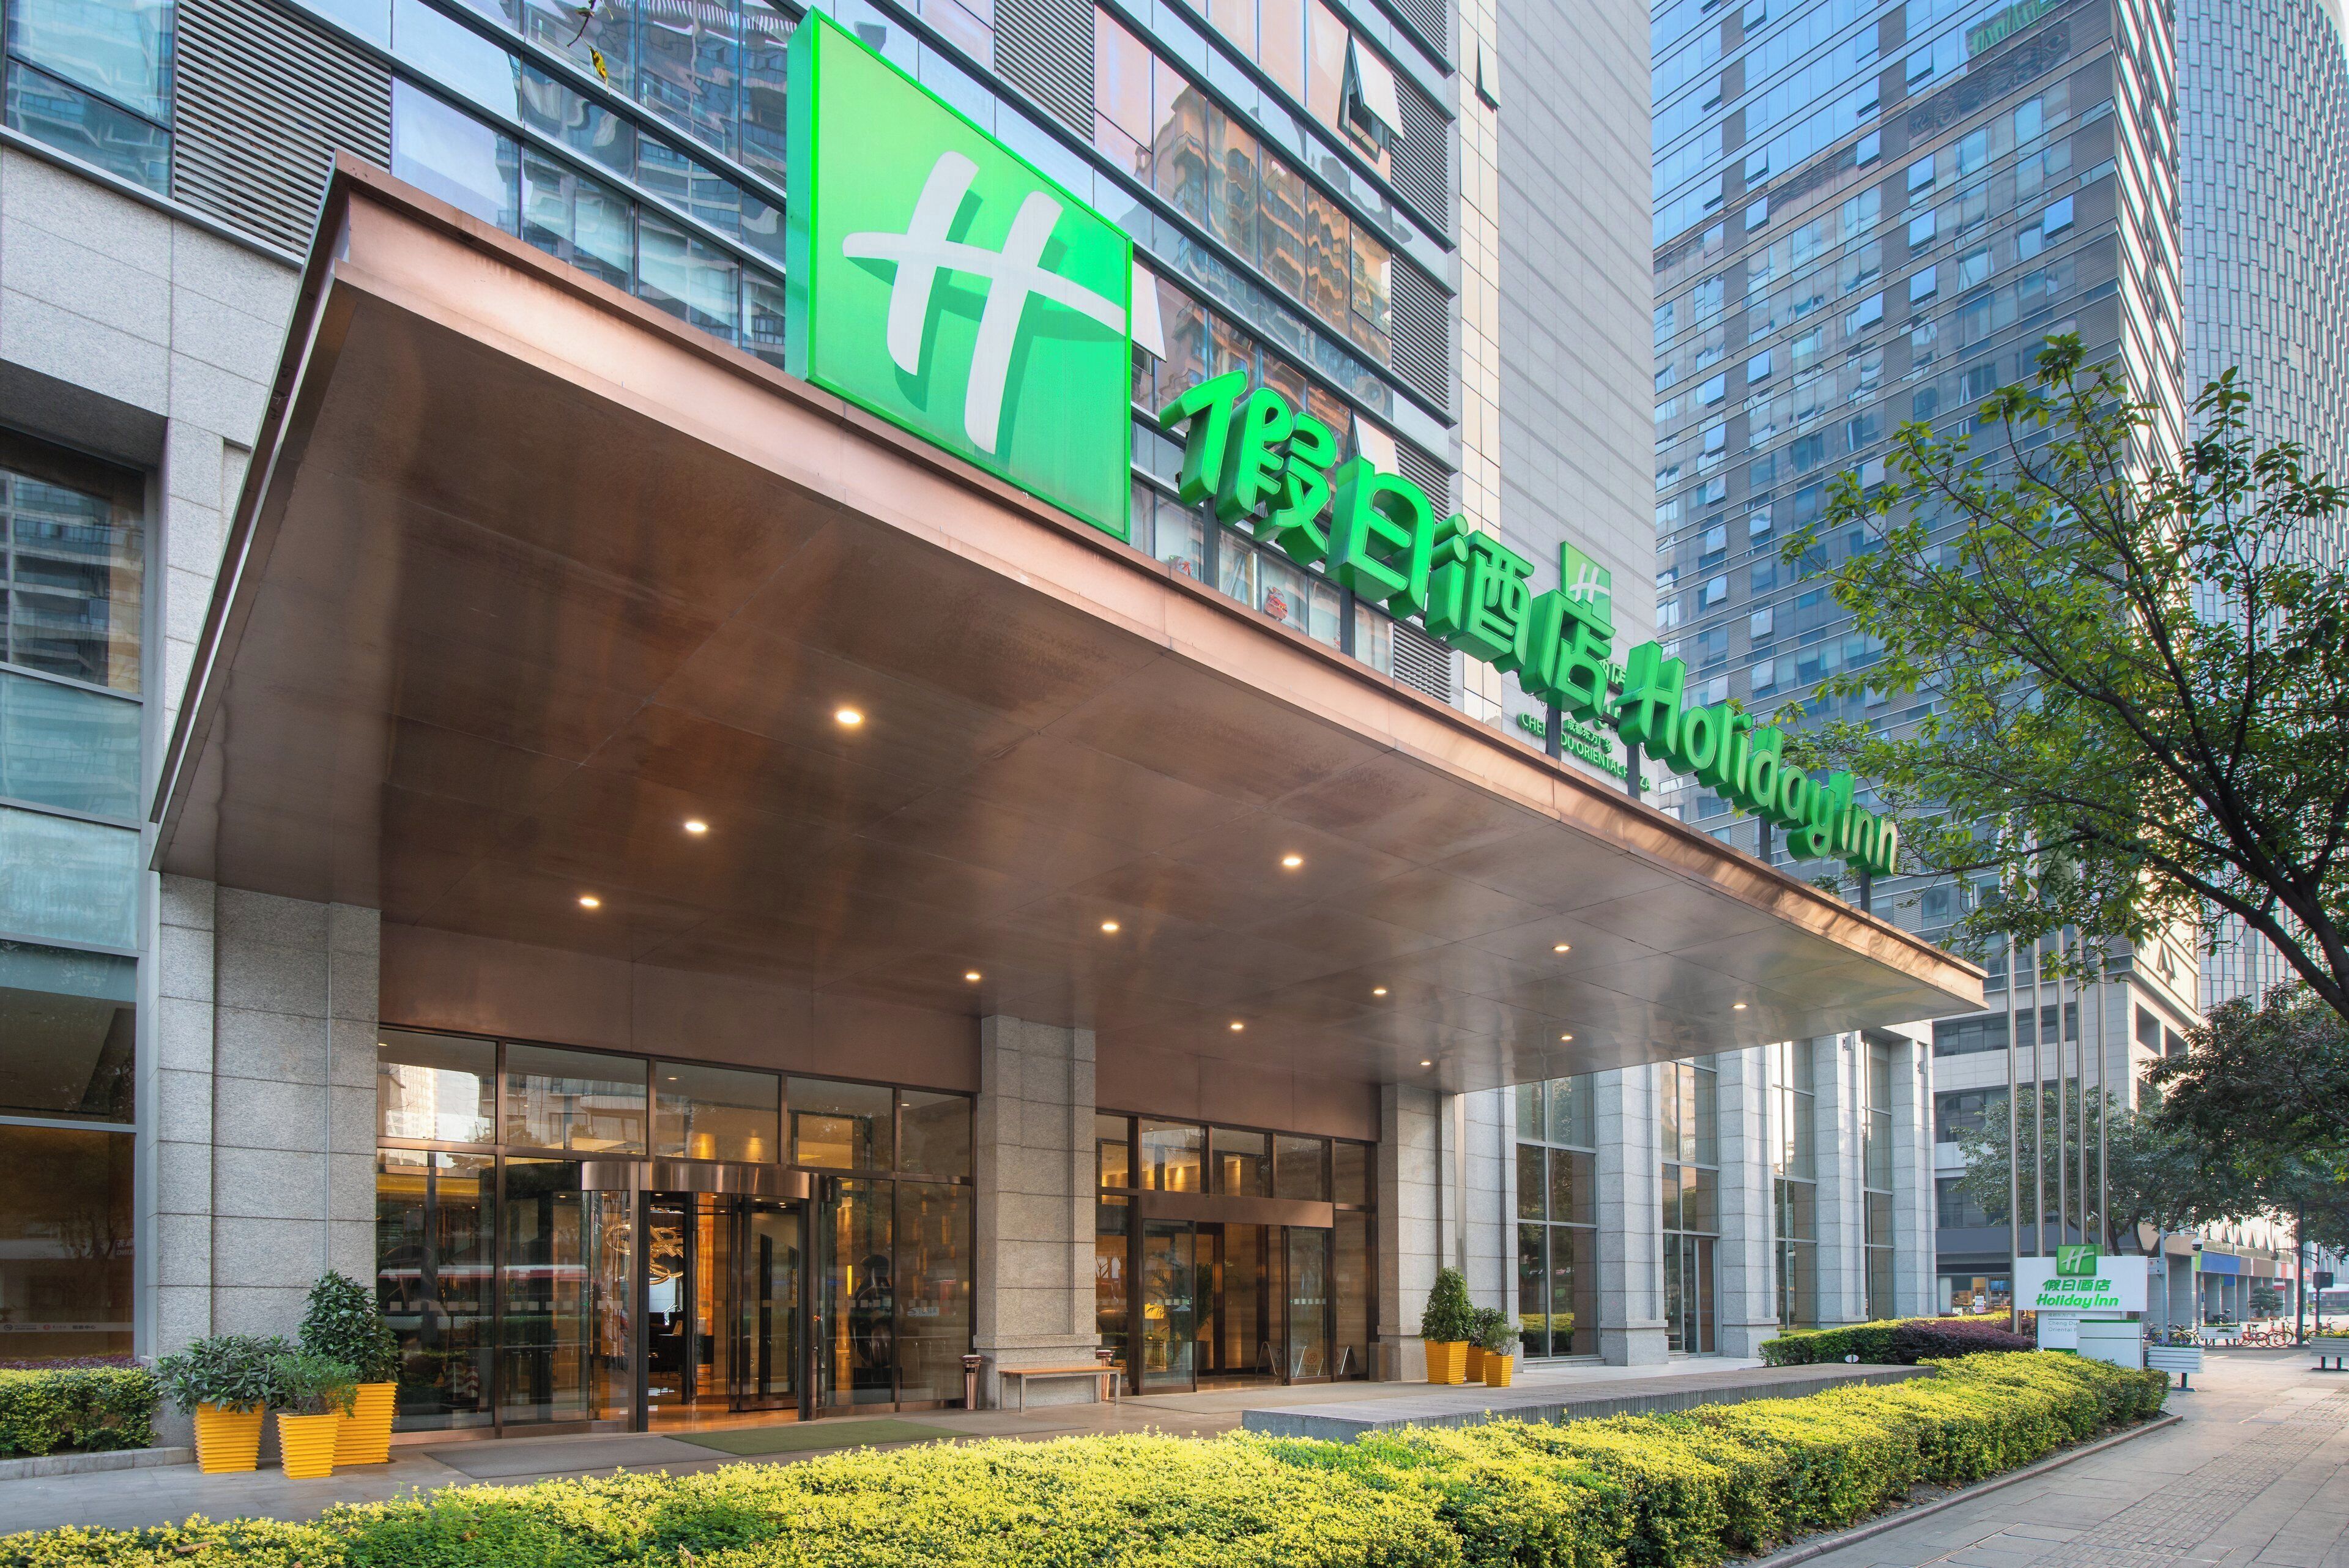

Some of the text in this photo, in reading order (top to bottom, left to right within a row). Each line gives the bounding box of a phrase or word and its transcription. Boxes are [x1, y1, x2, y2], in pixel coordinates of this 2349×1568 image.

[1159, 370, 1616, 723] 假日酒店
[1564, 718, 1613, 754] 成都东方广场
[1573, 741, 1622, 778] ORIENTAL
[1615, 641, 1898, 879] Holiday Inn
[2036, 1293, 2119, 1309] Holiday Inn
[2042, 1279, 2112, 1291] 假日酒店
